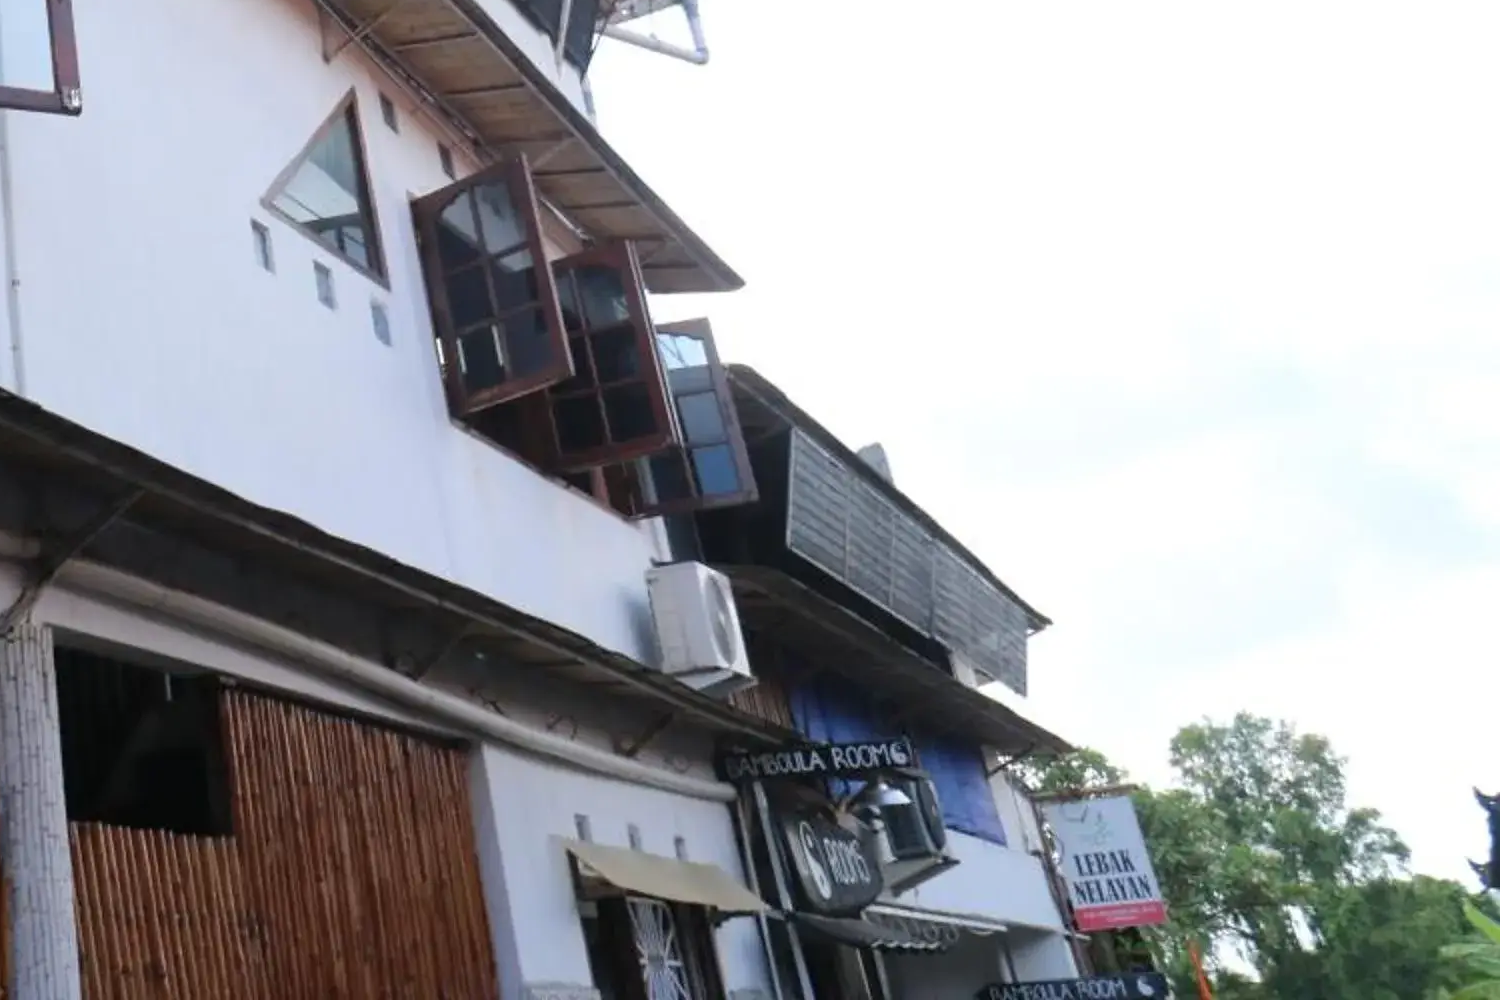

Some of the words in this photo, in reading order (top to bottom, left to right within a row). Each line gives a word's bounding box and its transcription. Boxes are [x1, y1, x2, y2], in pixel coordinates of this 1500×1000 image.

[831, 744, 888, 770] ROOM
[1073, 849, 1136, 877] LEBAK
[1073, 873, 1153, 904] NELAYAN
